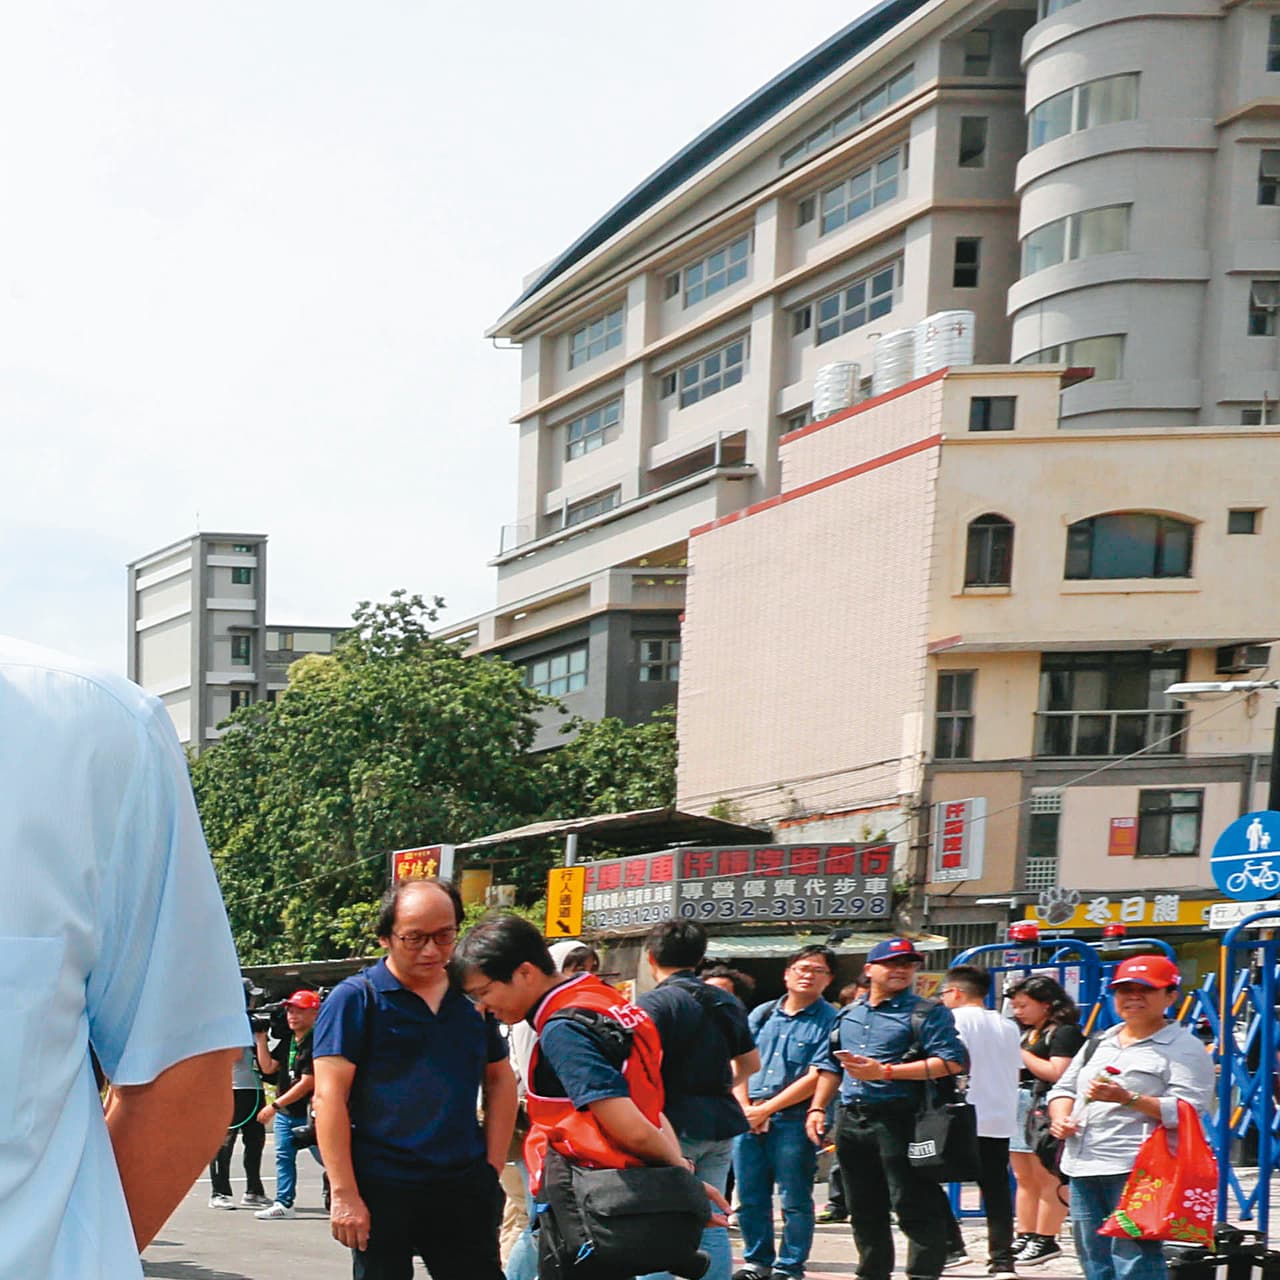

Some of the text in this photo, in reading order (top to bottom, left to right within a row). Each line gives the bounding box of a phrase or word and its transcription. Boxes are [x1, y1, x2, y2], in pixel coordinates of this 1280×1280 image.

[560, 870, 573, 918] 行人通道
[681, 878, 888, 900] 專營優質代步車
[681, 897, 886, 919] 0932-331298
